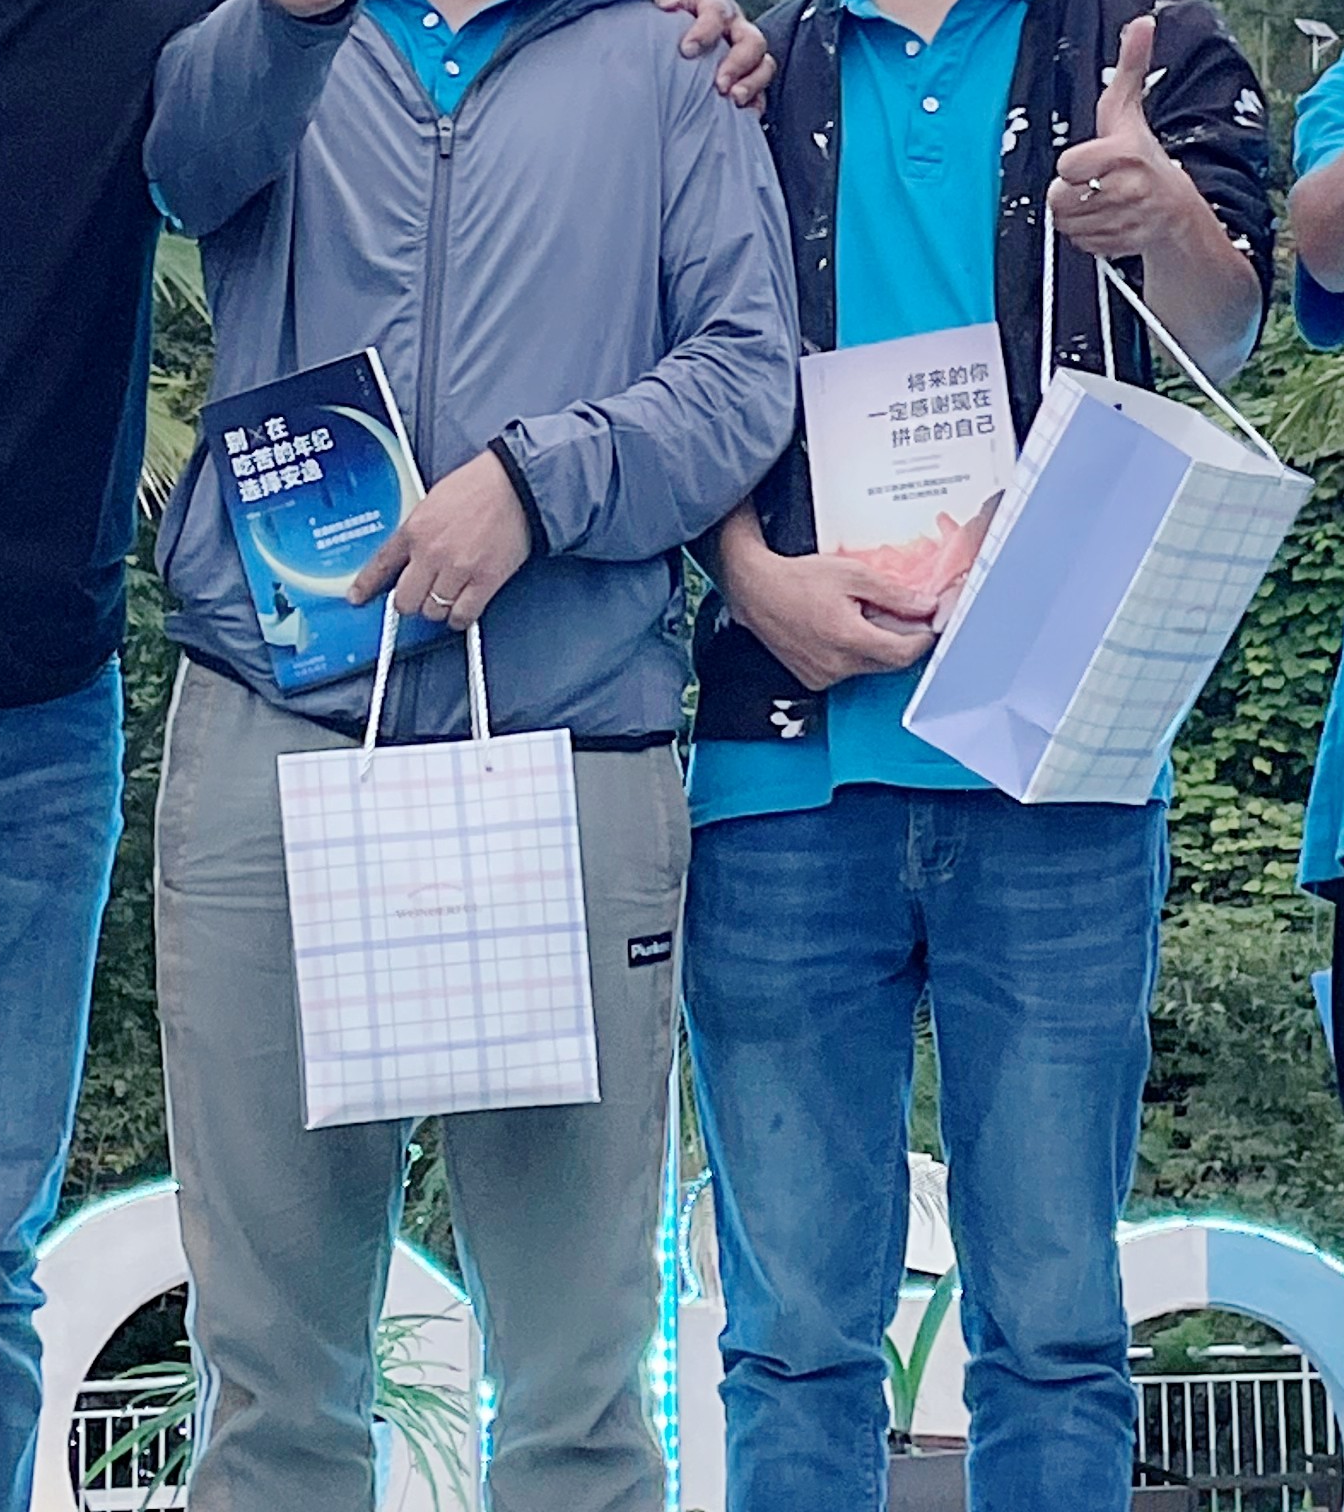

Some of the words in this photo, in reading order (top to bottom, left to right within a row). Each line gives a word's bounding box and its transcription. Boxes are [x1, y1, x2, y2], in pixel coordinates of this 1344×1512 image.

[907, 363, 989, 392] 将来的你
[868, 389, 992, 422] 一定感谢现在
[892, 414, 995, 448] 拼命的自己
[231, 428, 335, 478] 吃苦的年纪
[237, 459, 323, 503] 选择安逸
